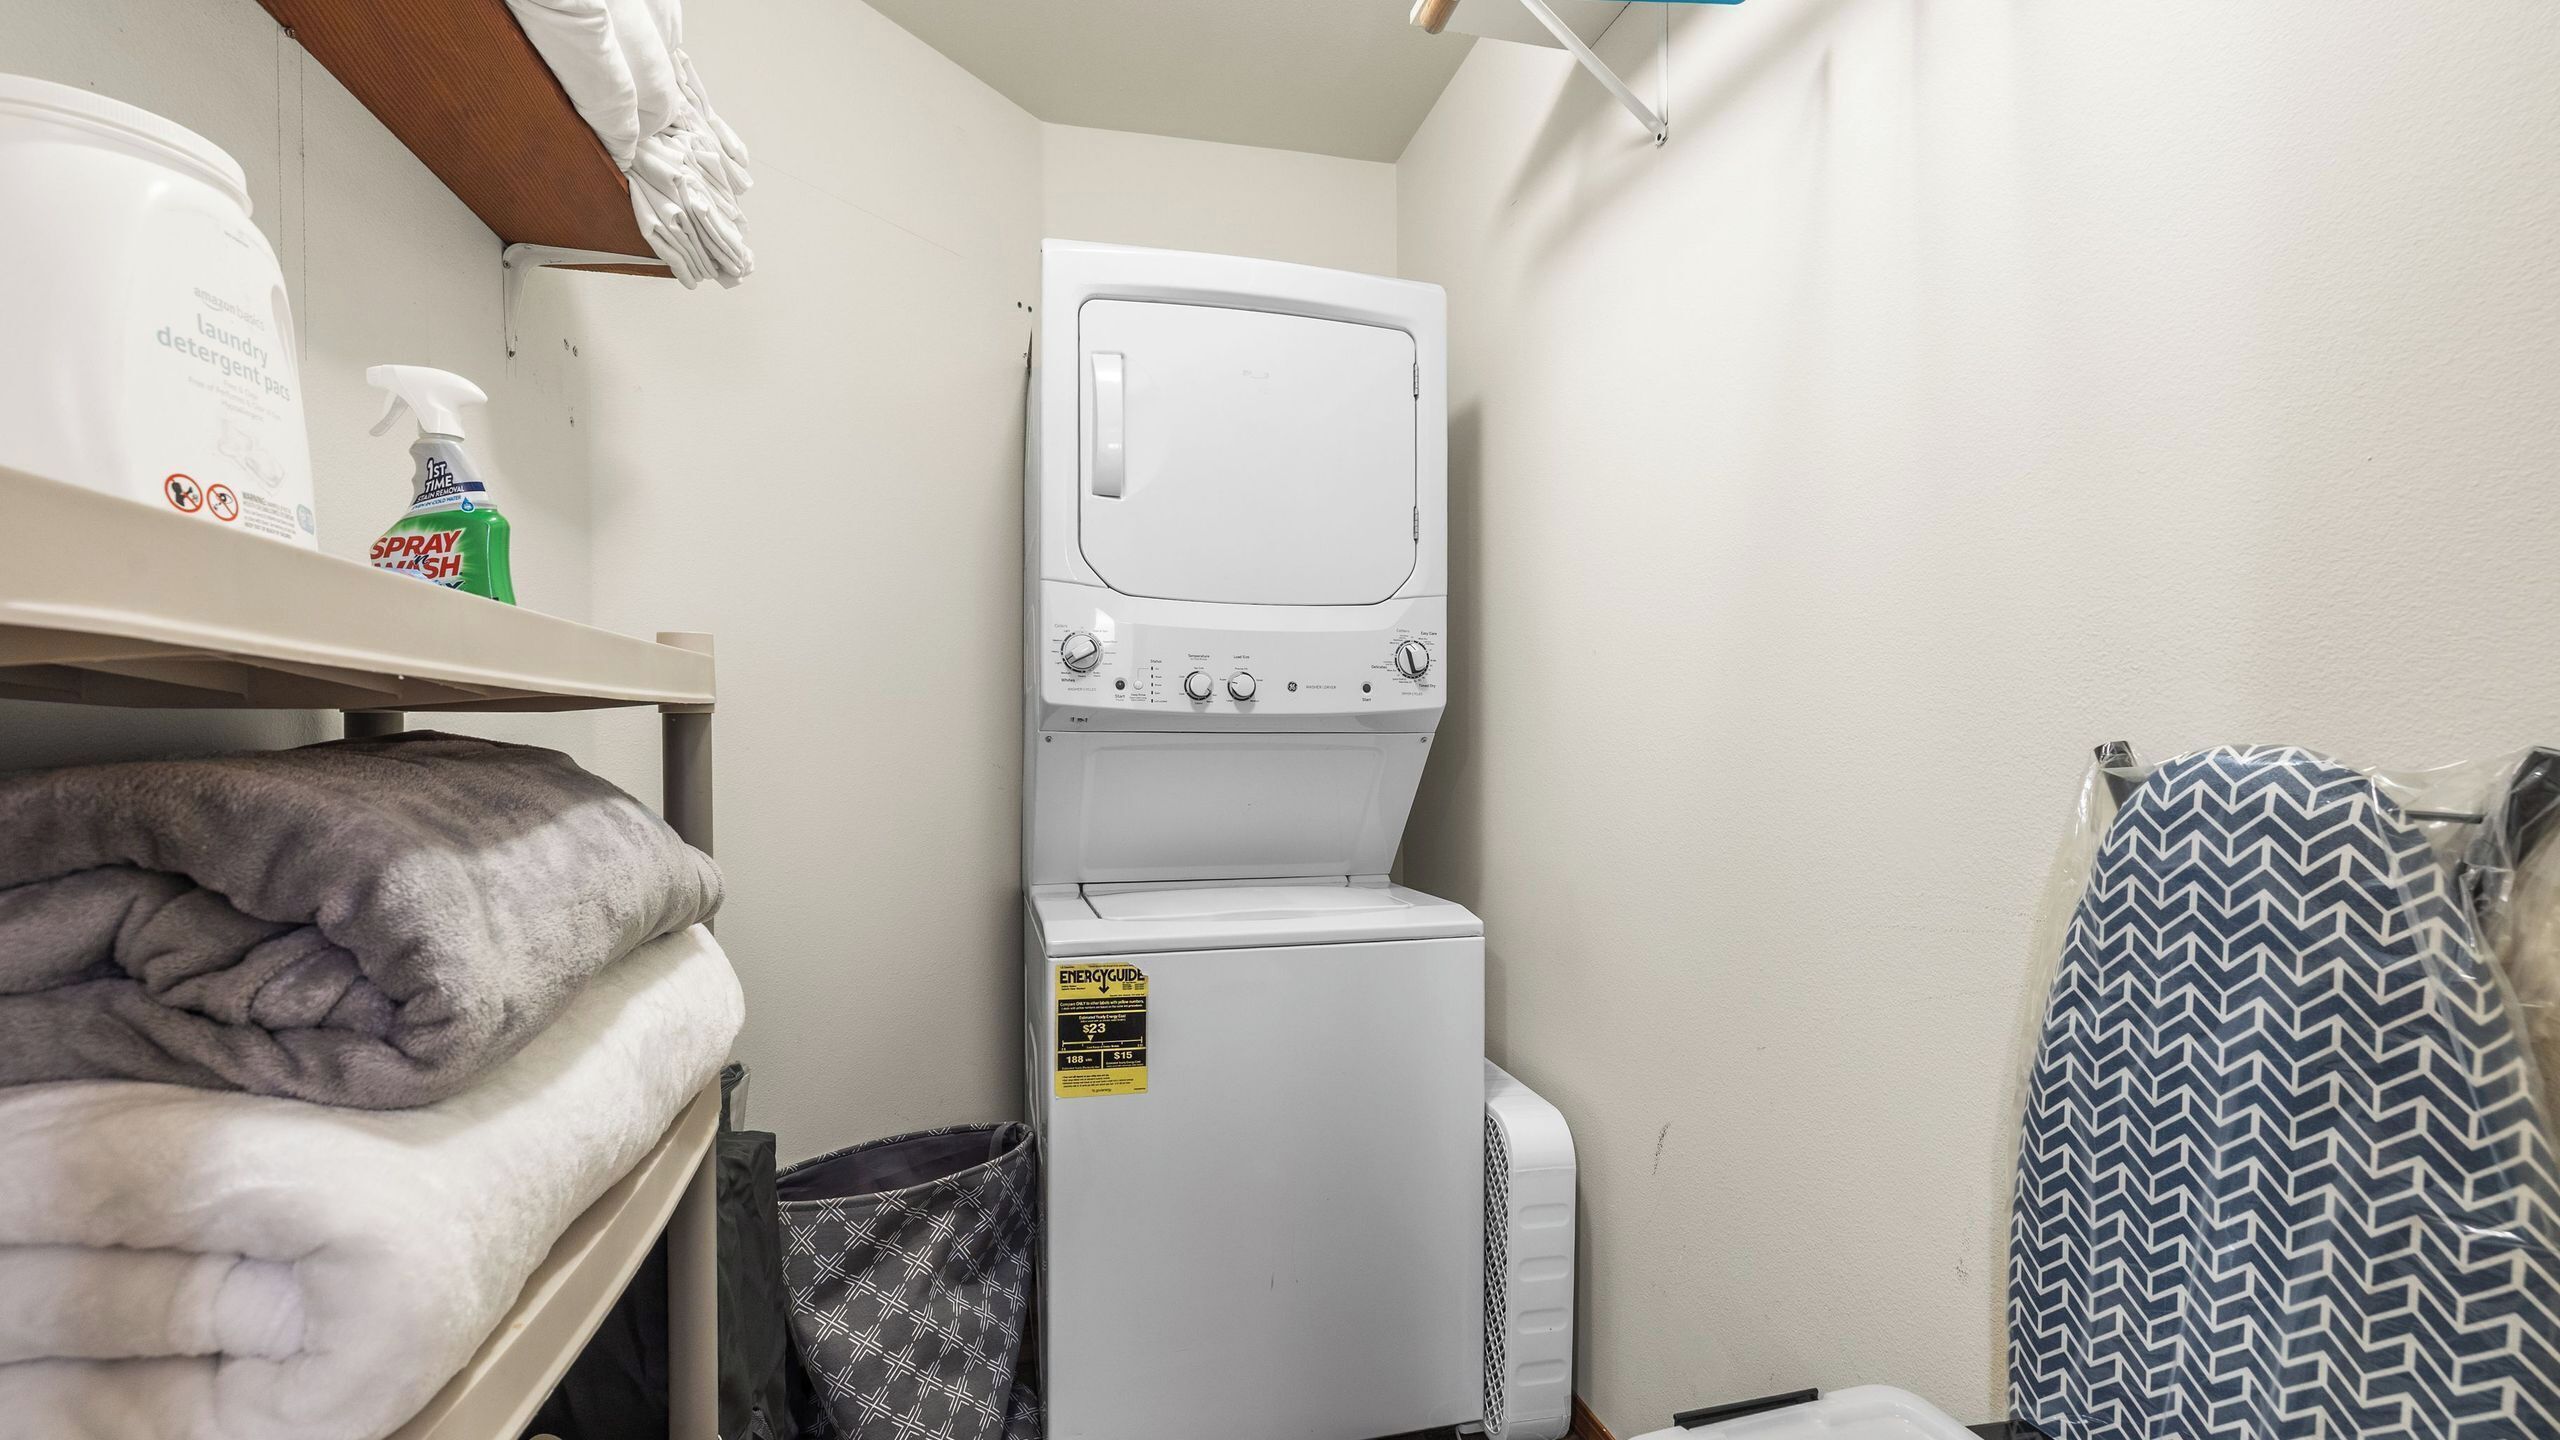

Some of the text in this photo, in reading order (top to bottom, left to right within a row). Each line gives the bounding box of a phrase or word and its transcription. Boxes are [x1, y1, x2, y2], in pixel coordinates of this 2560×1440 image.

[197, 313, 267, 369] laundry
[156, 326, 261, 385] detergent
[264, 376, 290, 401] pacs
[425, 476, 453, 493] TIME
[435, 485, 465, 497] REMOVAL
[370, 530, 462, 560] SPRAY
[1059, 968, 1146, 985] ENERGYGUIDE
[1082, 1022, 1106, 1034] $23
[1066, 1055, 1084, 1064] 188
[1113, 1051, 1133, 1060] $15
